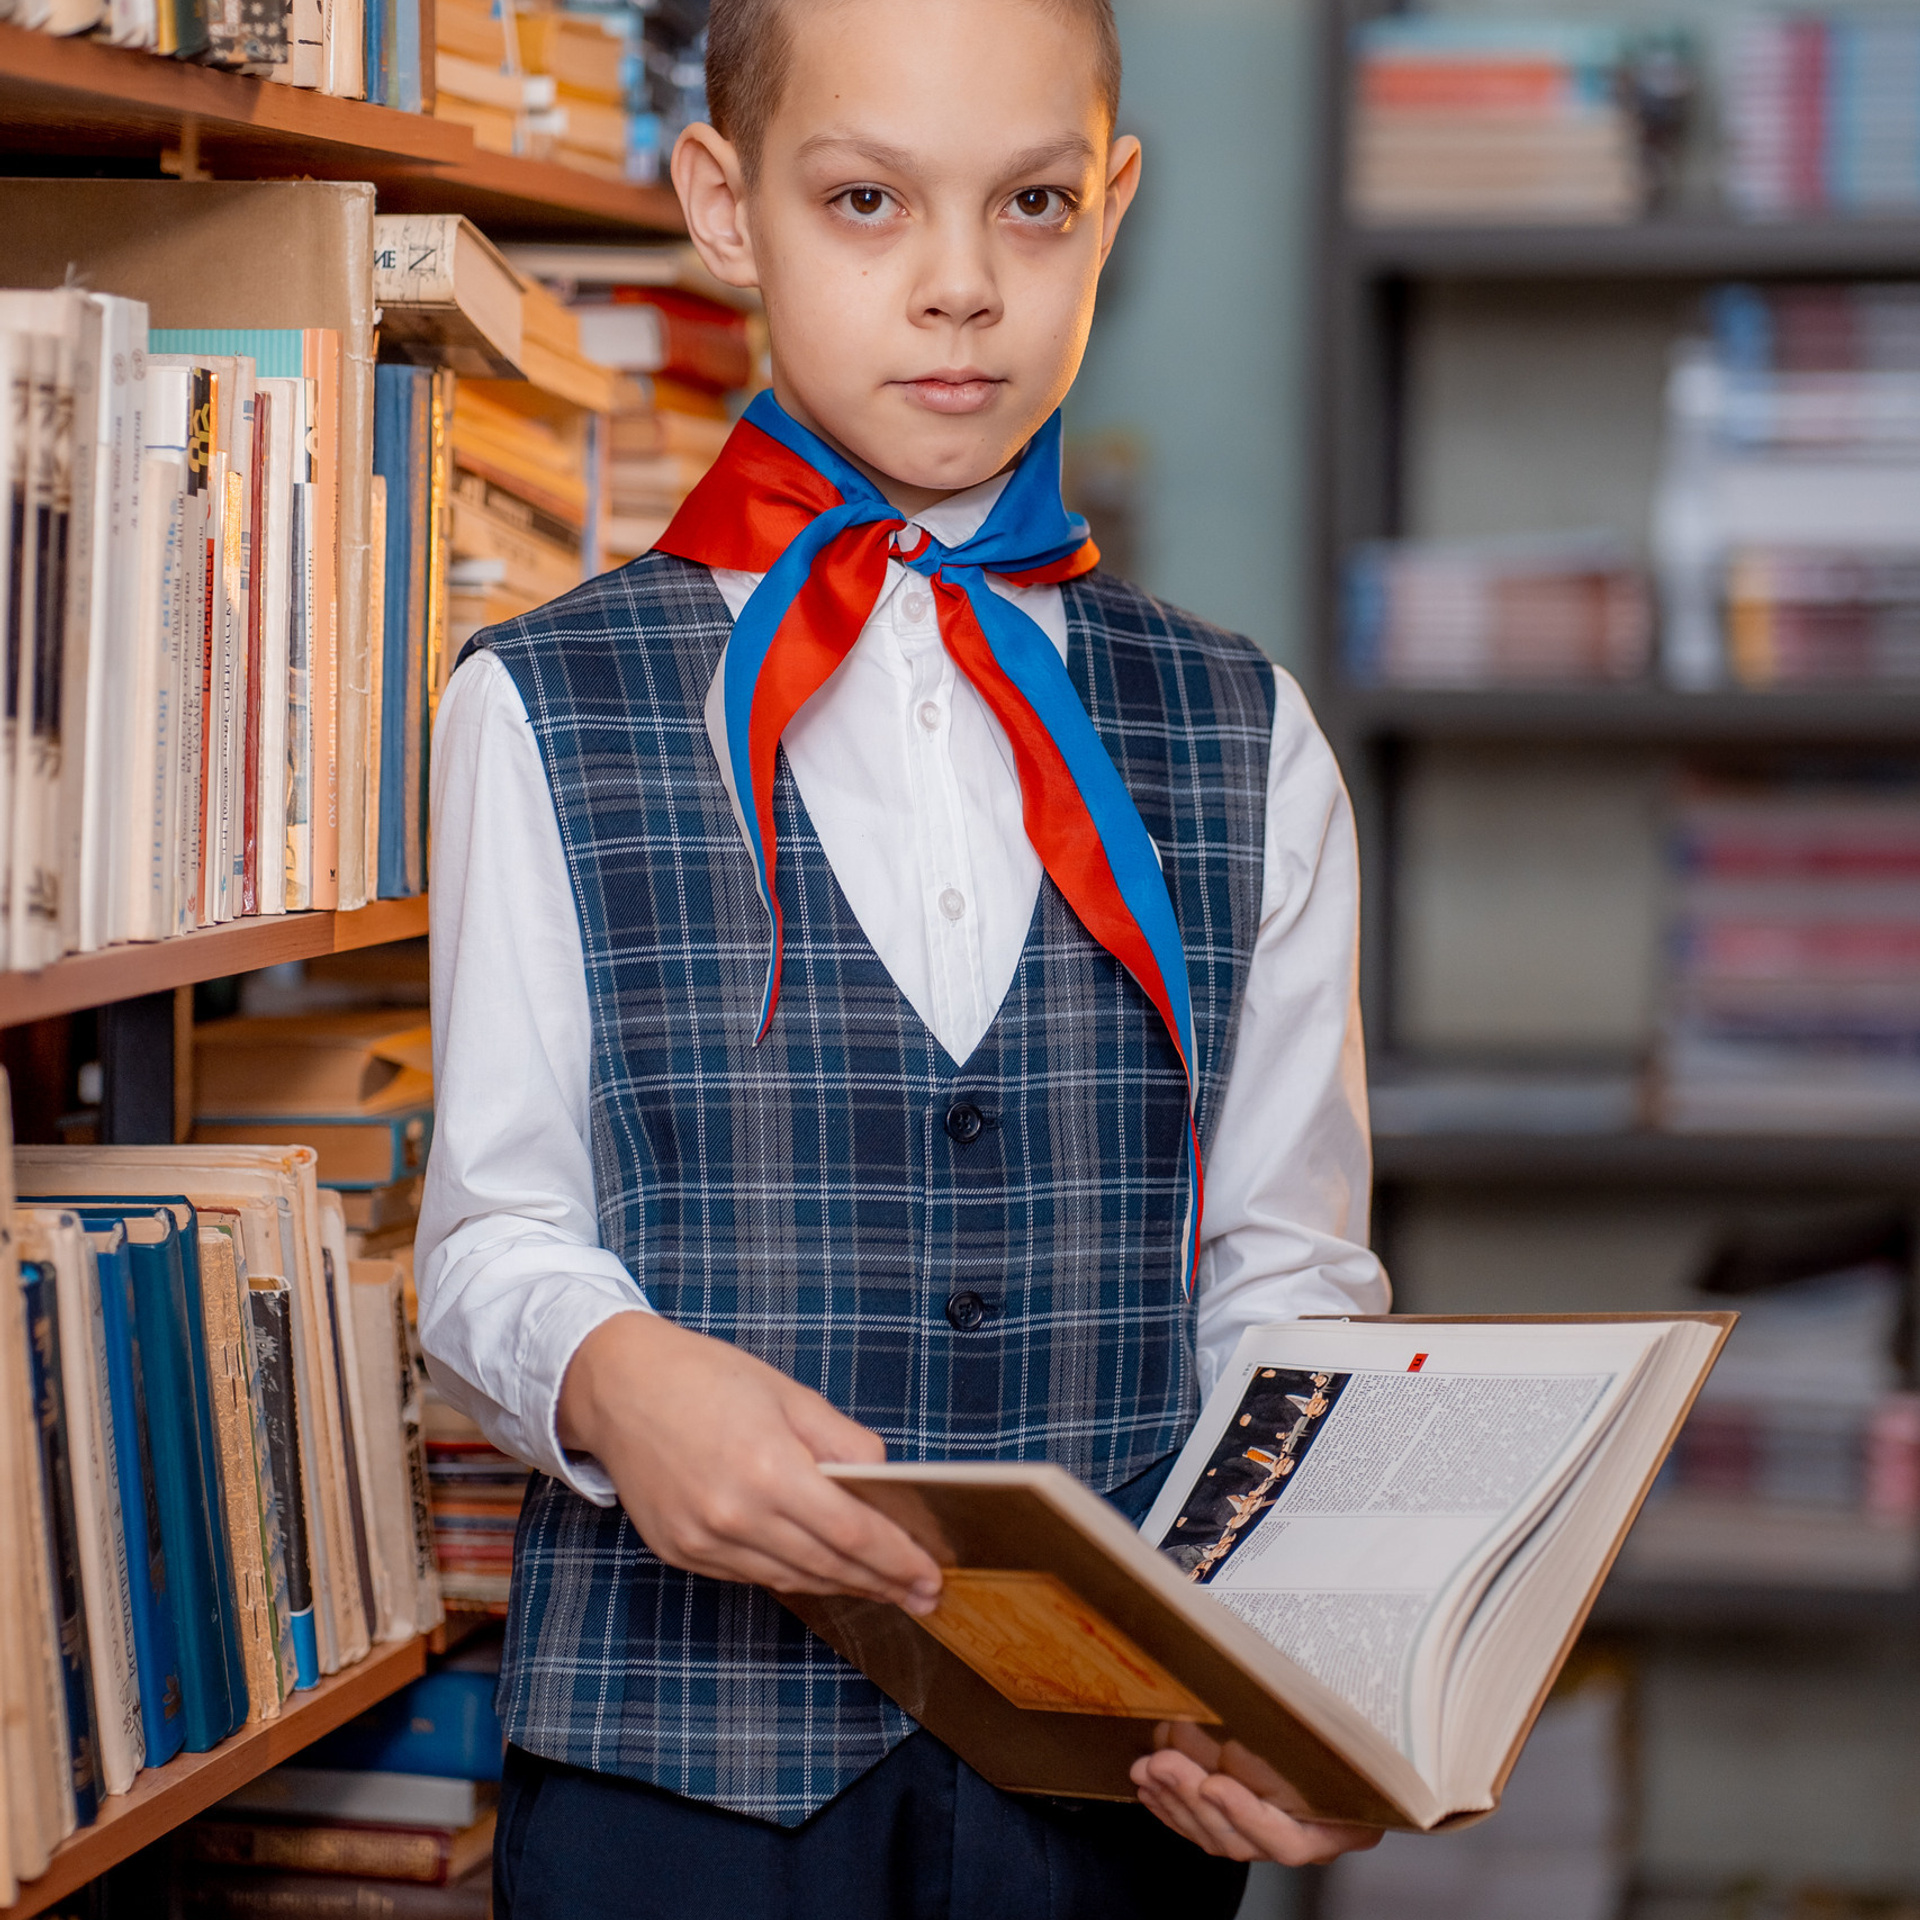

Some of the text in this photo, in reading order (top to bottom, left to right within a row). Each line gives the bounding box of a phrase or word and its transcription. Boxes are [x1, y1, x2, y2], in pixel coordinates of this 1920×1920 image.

[197, 527, 205, 592] рассказы
[183, 572, 191, 686] ОТРОЧЕСТВО
[194, 609, 203, 669] Повести
[329, 602, 338, 665] БЕЛЫЙ
[193, 686, 201, 755] КАЗАКИ
[329, 671, 338, 711] БИМ
[328, 792, 337, 828] УХО
[116, 1529, 133, 1642] ТУРГЕНЕВ
